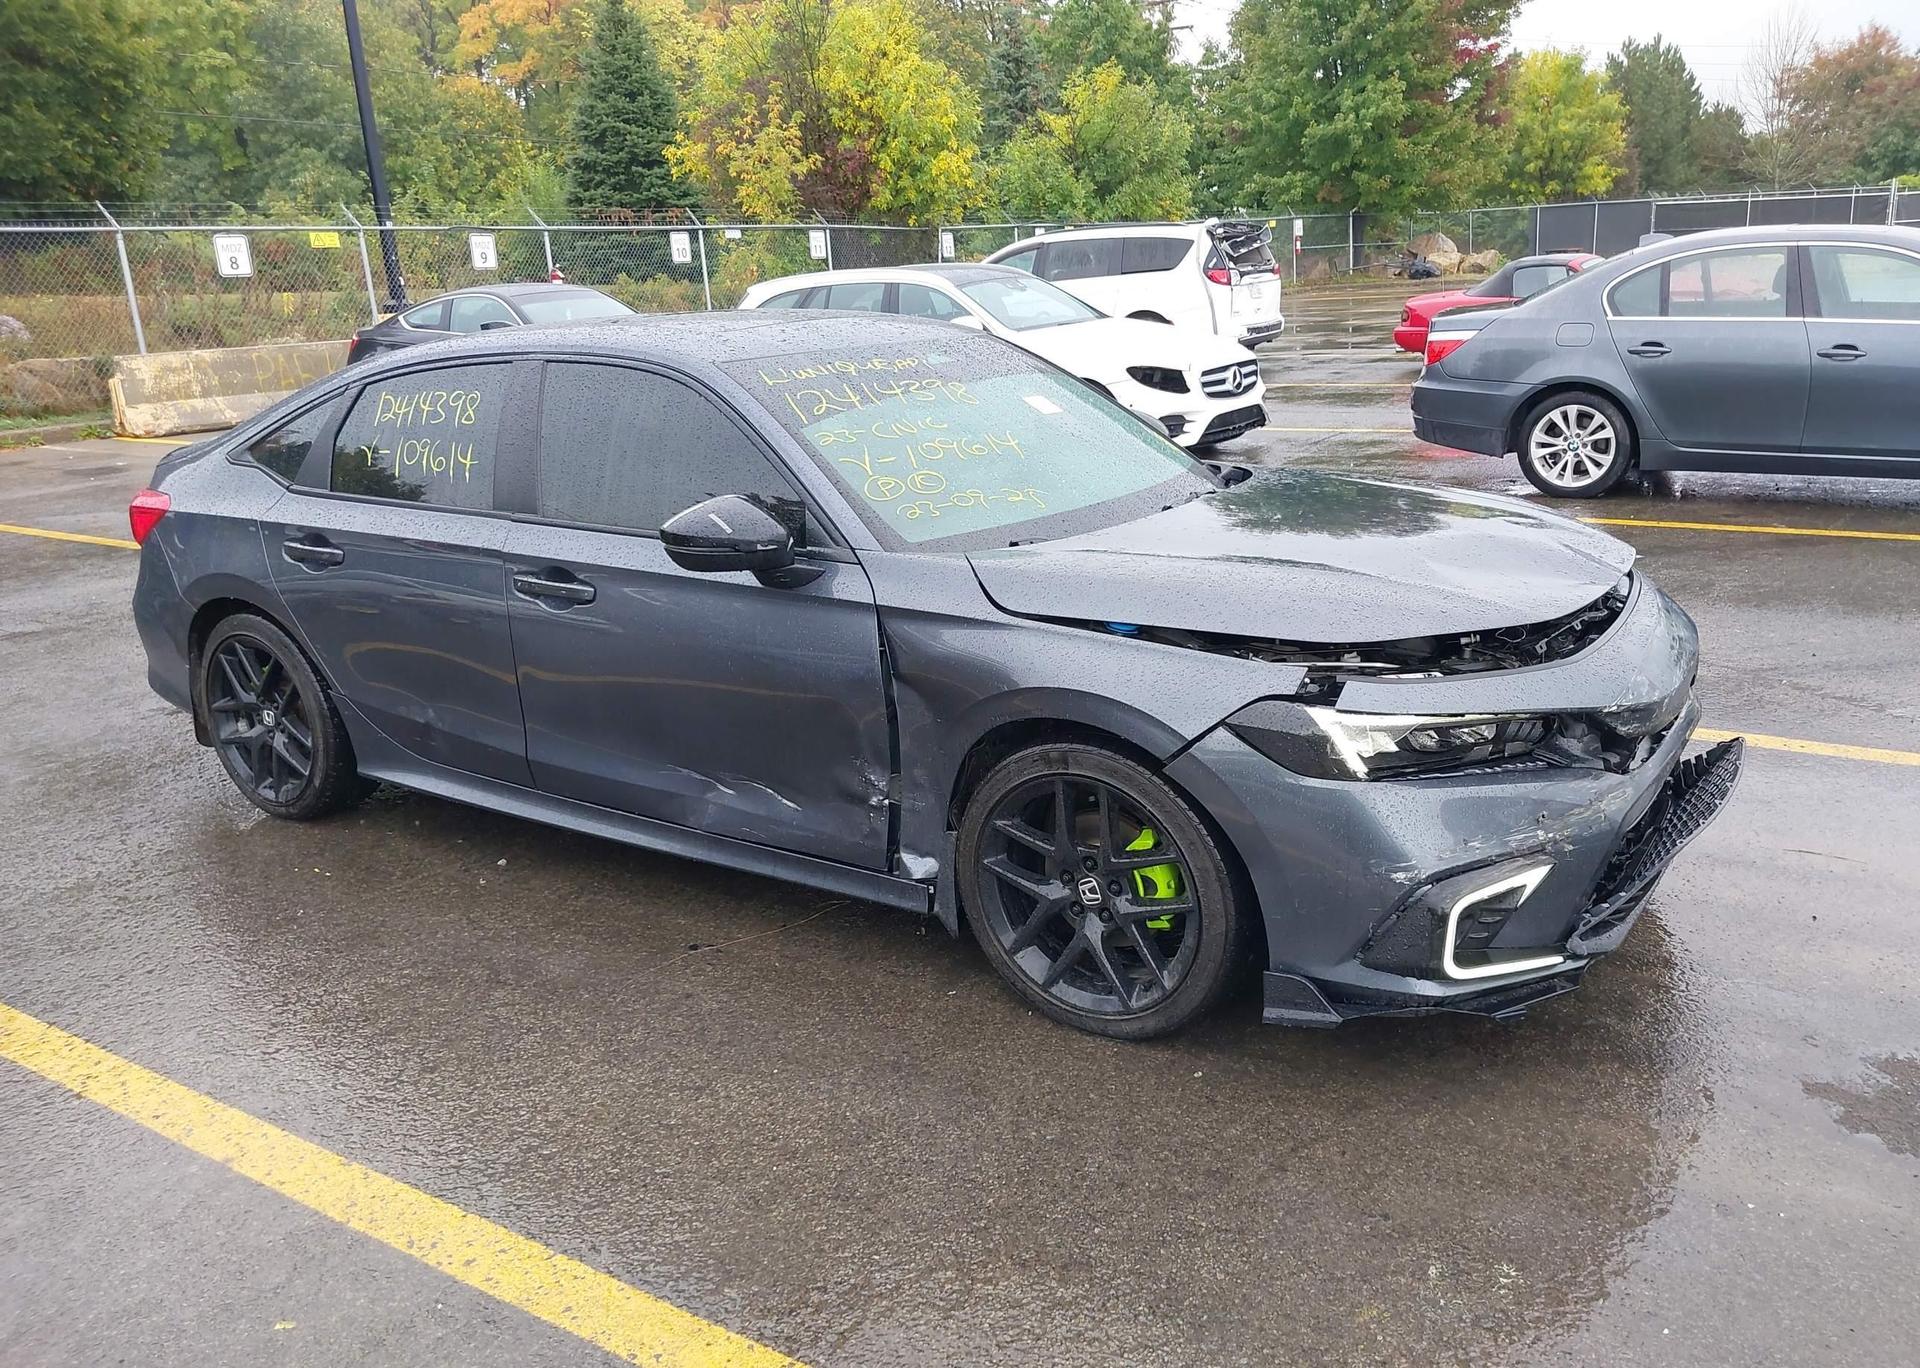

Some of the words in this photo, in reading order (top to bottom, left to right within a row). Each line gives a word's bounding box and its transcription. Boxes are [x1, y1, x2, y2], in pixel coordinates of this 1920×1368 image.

[480, 251, 488, 264] 9
[676, 247, 687, 258] 10
[229, 256, 240, 270] 8
[785, 378, 980, 424] 12414398
[374, 390, 481, 428] 12414398
